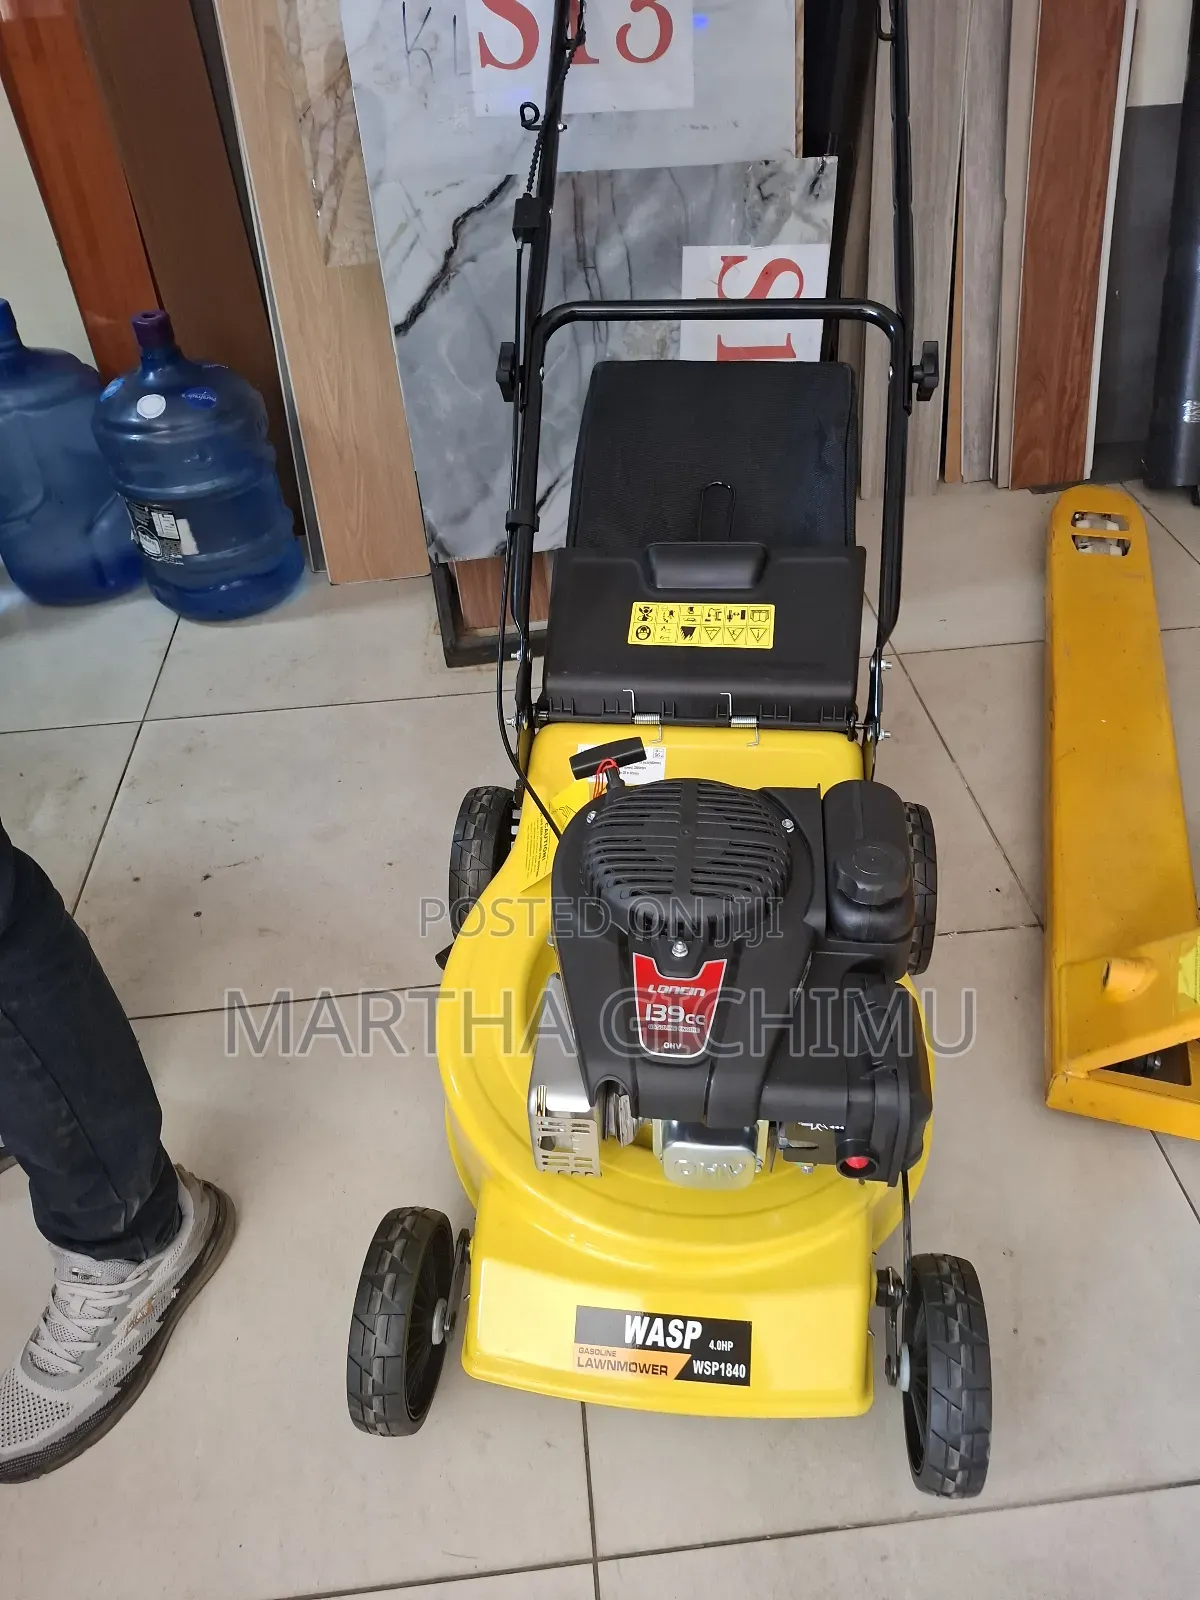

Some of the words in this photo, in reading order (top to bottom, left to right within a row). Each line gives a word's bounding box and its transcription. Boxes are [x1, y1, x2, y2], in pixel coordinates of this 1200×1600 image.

[663, 1041, 682, 1050] OHV
[625, 1314, 703, 1350] WASP
[578, 1347, 617, 1358] GASOLINE
[708, 1339, 734, 1352] 4.0HP
[577, 1356, 668, 1376] LAWNMOWER
[692, 1359, 746, 1379] WSP1840
